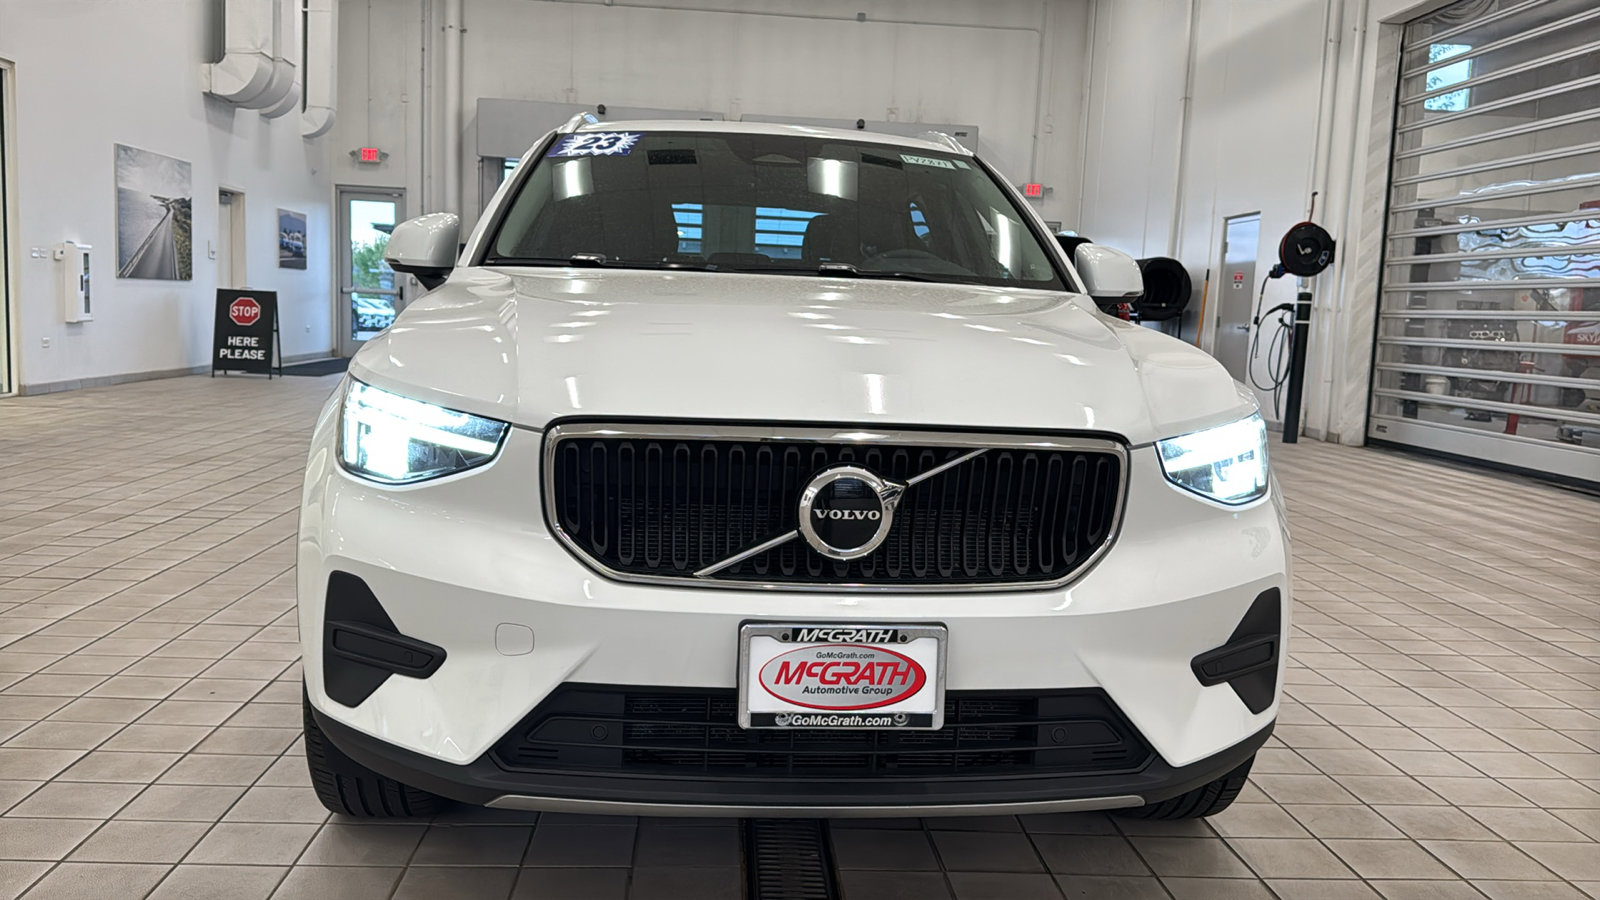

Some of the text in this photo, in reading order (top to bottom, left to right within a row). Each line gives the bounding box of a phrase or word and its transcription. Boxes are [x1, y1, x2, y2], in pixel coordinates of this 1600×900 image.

[573, 136, 622, 150] 23
[231, 305, 259, 317] STOP
[227, 336, 259, 347] HERE
[219, 348, 266, 360] PLEASE
[813, 508, 881, 520] VOLVO
[815, 651, 875, 660] GoMcGrath.com
[802, 685, 893, 696] Automotive Group
[791, 714, 892, 727] GoMcGrath.com
